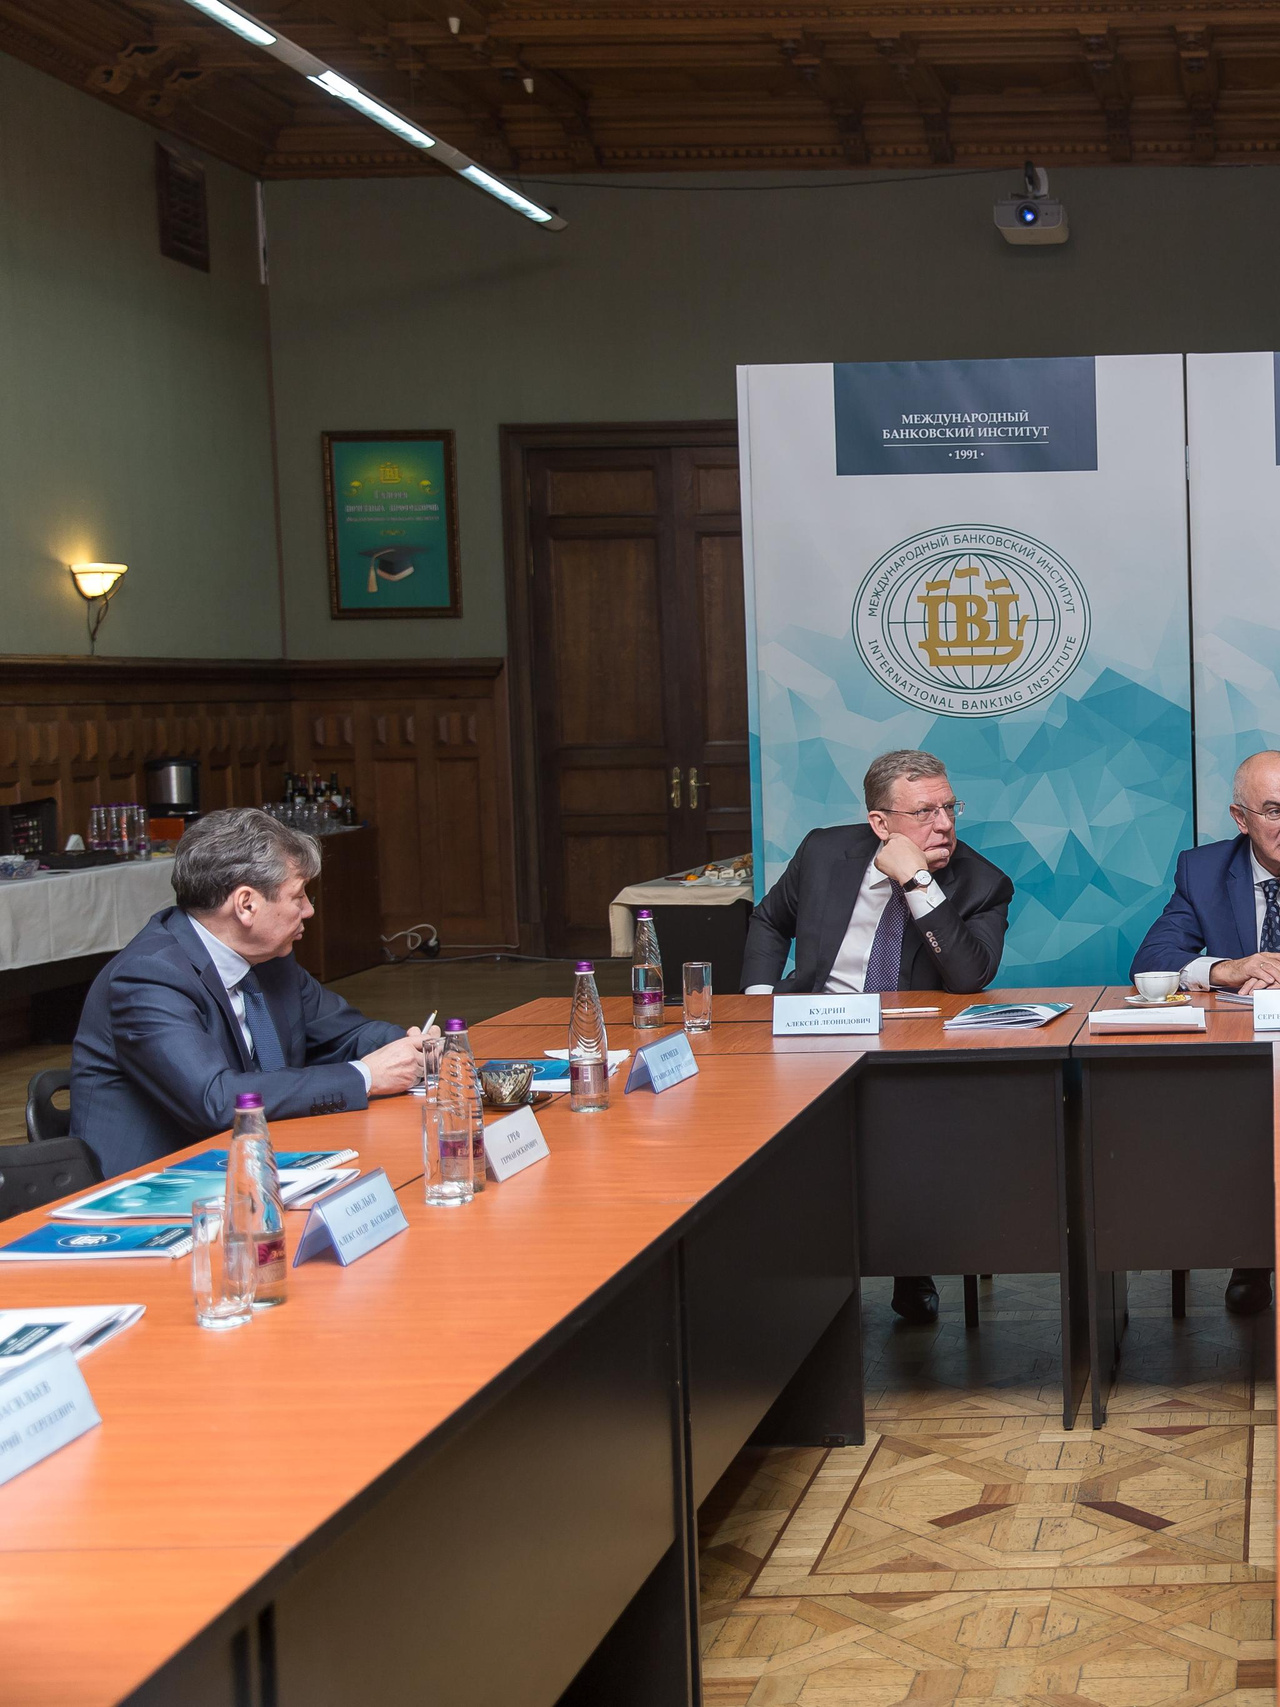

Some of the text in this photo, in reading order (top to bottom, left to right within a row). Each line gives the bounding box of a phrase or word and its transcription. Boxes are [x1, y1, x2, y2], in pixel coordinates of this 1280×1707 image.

[902, 410, 1030, 426] МЕЖДУНАРОДНЫЙ
[882, 426, 1050, 440] БАНКОВСКИЙ ИНСТИТУТ
[954, 450, 978, 460] 1991
[868, 534, 1076, 617] МЕЖДУНАРОДНЫЙ БАНКОВСКИЙ ИНСТИТУТ
[868, 636, 1076, 710] INTERNATIONAL BANKING INSTITUTE
[809, 1007, 846, 1015] КУДРИН
[785, 1018, 871, 1028] АЛЕКСЕЙ ЛЕОНИДОВИЧ
[506, 1130, 520, 1144] ГРЕФ
[345, 1192, 377, 1217] САВЕЛЬЕВ
[339, 1222, 370, 1247] АЛЕКСАНДР
